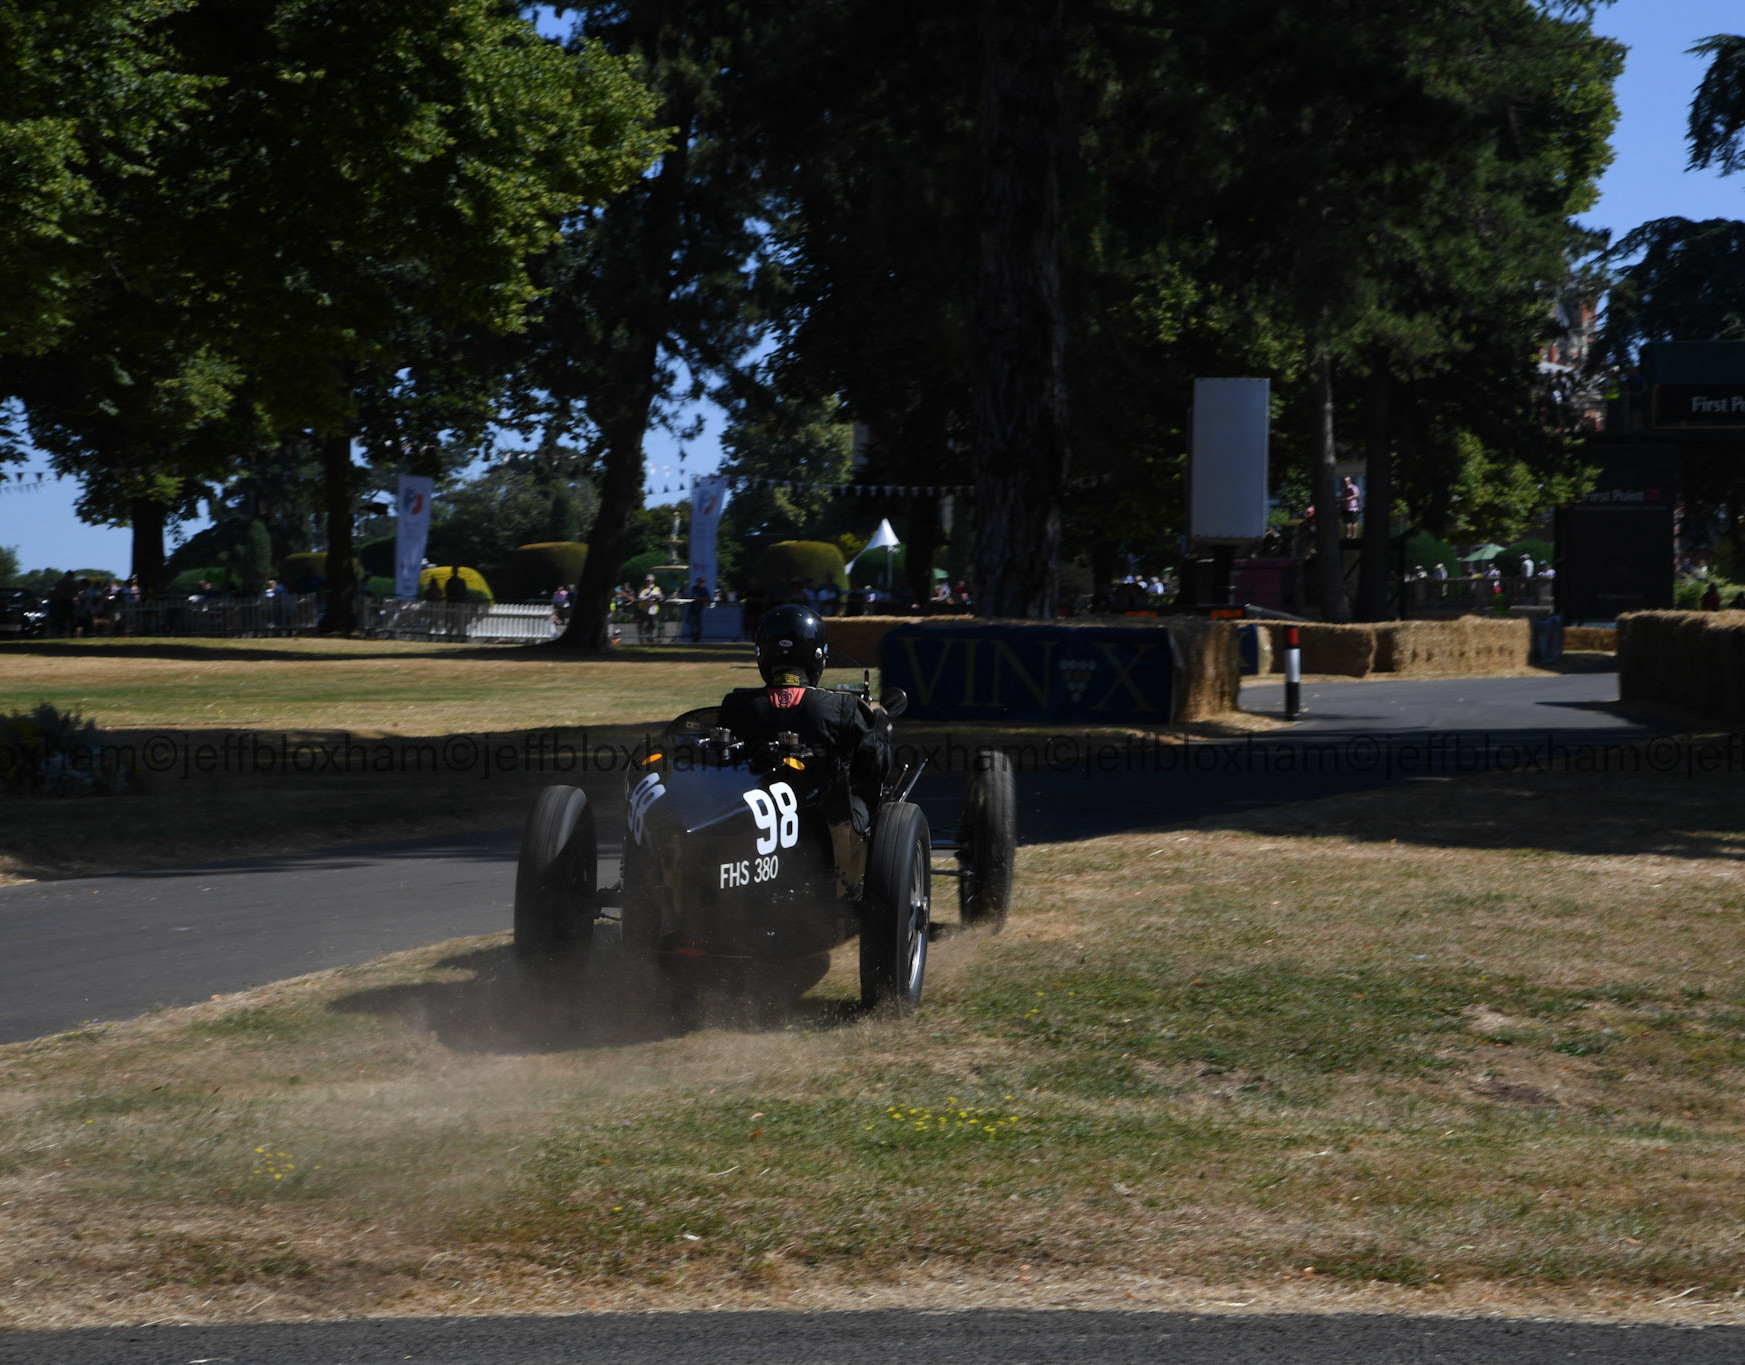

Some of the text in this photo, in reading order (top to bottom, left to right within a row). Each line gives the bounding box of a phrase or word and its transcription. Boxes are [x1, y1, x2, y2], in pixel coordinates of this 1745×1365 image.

[1691, 396, 1729, 413] First
[743, 781, 799, 855] 98
[720, 855, 779, 889] FHS 380
